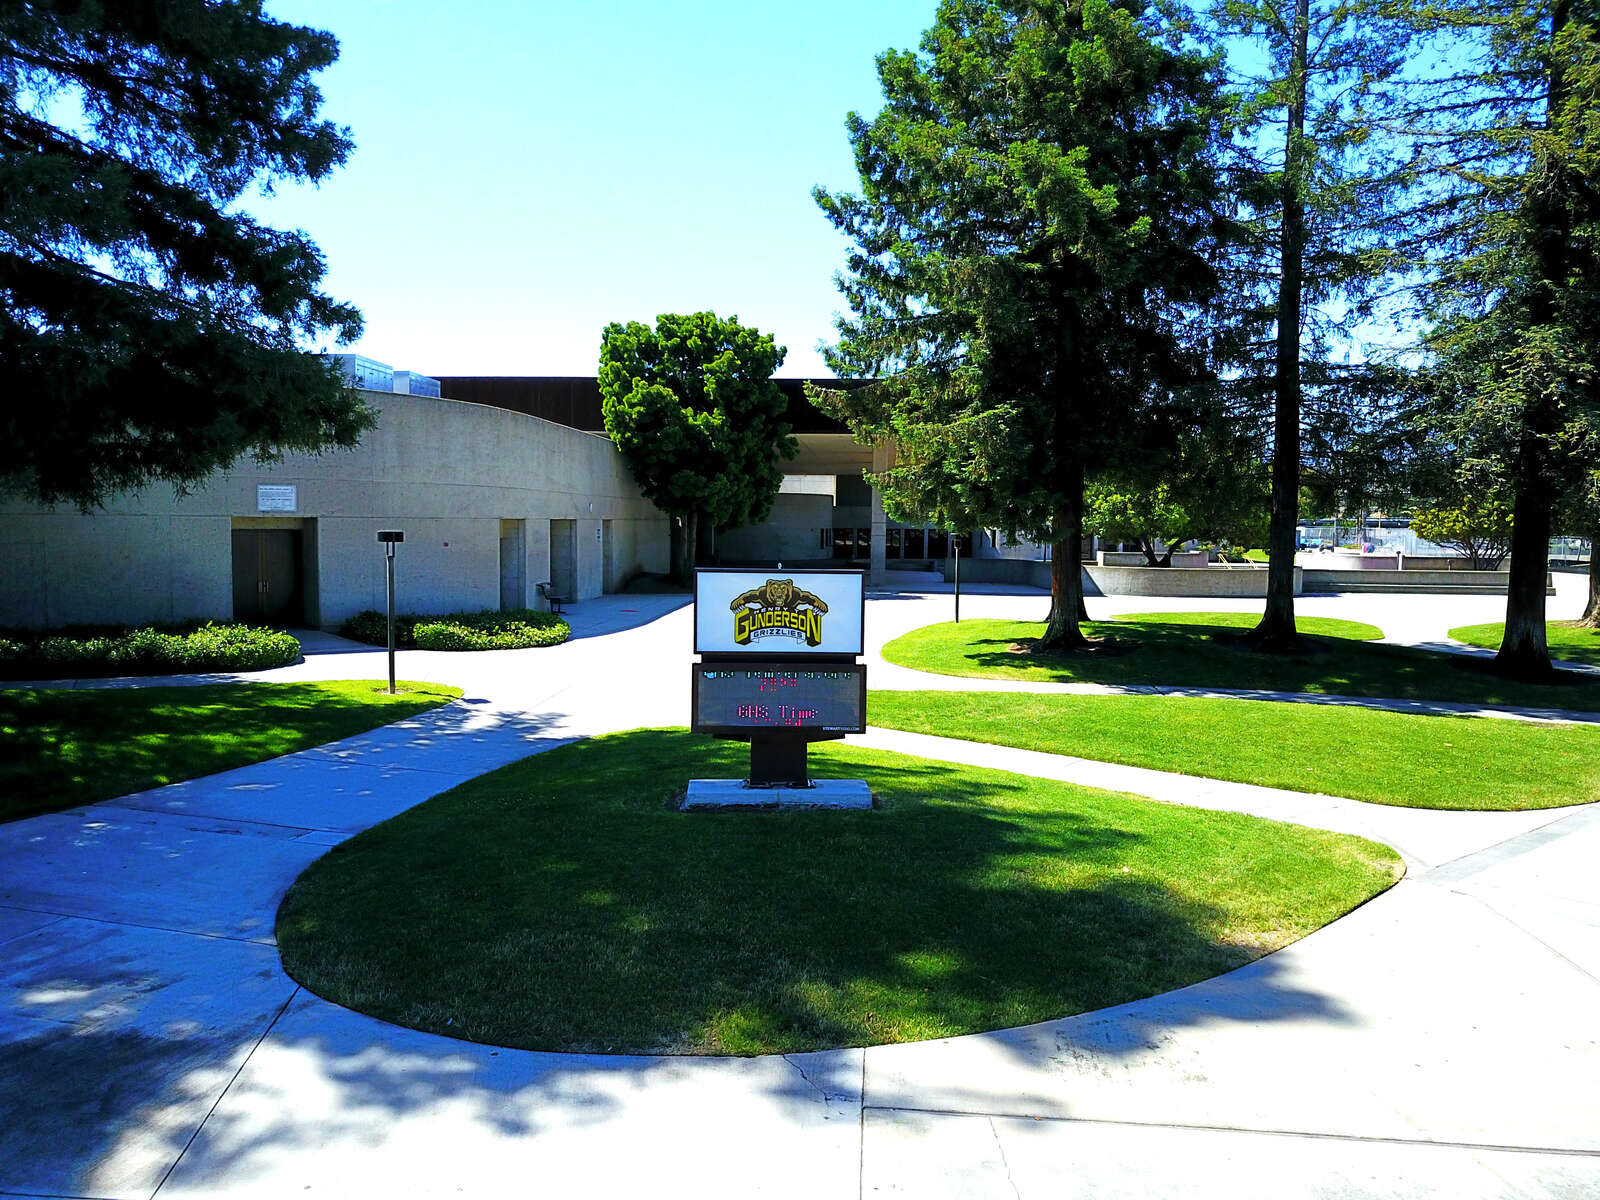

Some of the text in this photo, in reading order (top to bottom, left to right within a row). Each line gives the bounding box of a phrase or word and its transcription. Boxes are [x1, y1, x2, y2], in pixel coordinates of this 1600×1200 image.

[735, 607, 822, 644] GUNDERSON
[753, 628, 803, 638] GRIZZLIES
[778, 705, 818, 719] Time
